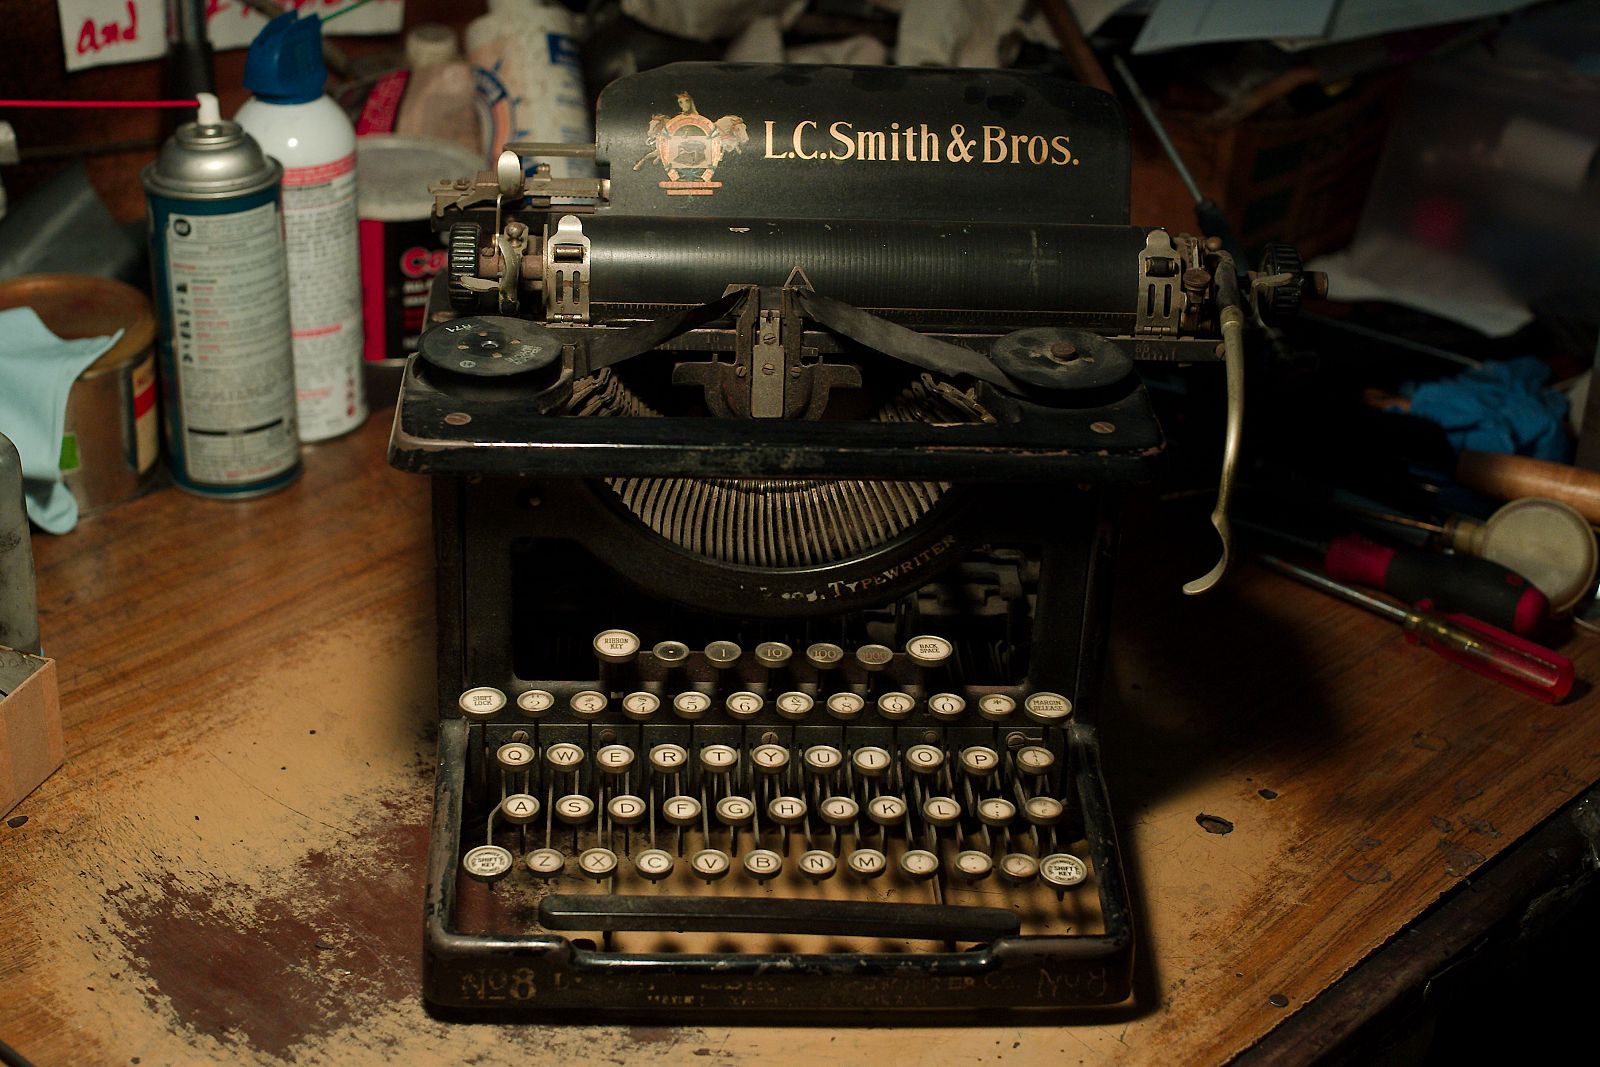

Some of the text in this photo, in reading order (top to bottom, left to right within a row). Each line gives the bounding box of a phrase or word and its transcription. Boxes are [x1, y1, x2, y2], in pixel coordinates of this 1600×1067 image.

[945, 123, 977, 163] &
[981, 125, 1080, 166] Bros.
[767, 648, 783, 658] 10
[814, 649, 837, 659] 100
[686, 701, 698, 710] 5
[739, 702, 751, 712] 6
[508, 750, 522, 761] Q
[556, 751, 574, 761] W
[610, 752, 622, 762] E
[663, 752, 676, 762] R
[712, 752, 726, 761] T
[764, 752, 777, 762] Y
[817, 753, 830, 763] U
[918, 751, 933, 762] O
[975, 754, 988, 765] P
[514, 801, 528, 812] A
[568, 802, 581, 813] S
[620, 803, 635, 813] D
[677, 804, 689, 814] F
[728, 804, 743, 814] G
[780, 804, 794, 814] H
[833, 805, 844, 815] J
[882, 804, 896, 814] K
[937, 805, 950, 815] L
[538, 855, 551, 867] Z
[591, 856, 606, 867] X
[647, 857, 661, 868] C
[704, 858, 718, 869] V
[756, 857, 771, 868] B
[810, 858, 824, 868] N
[858, 857, 875, 867] M
